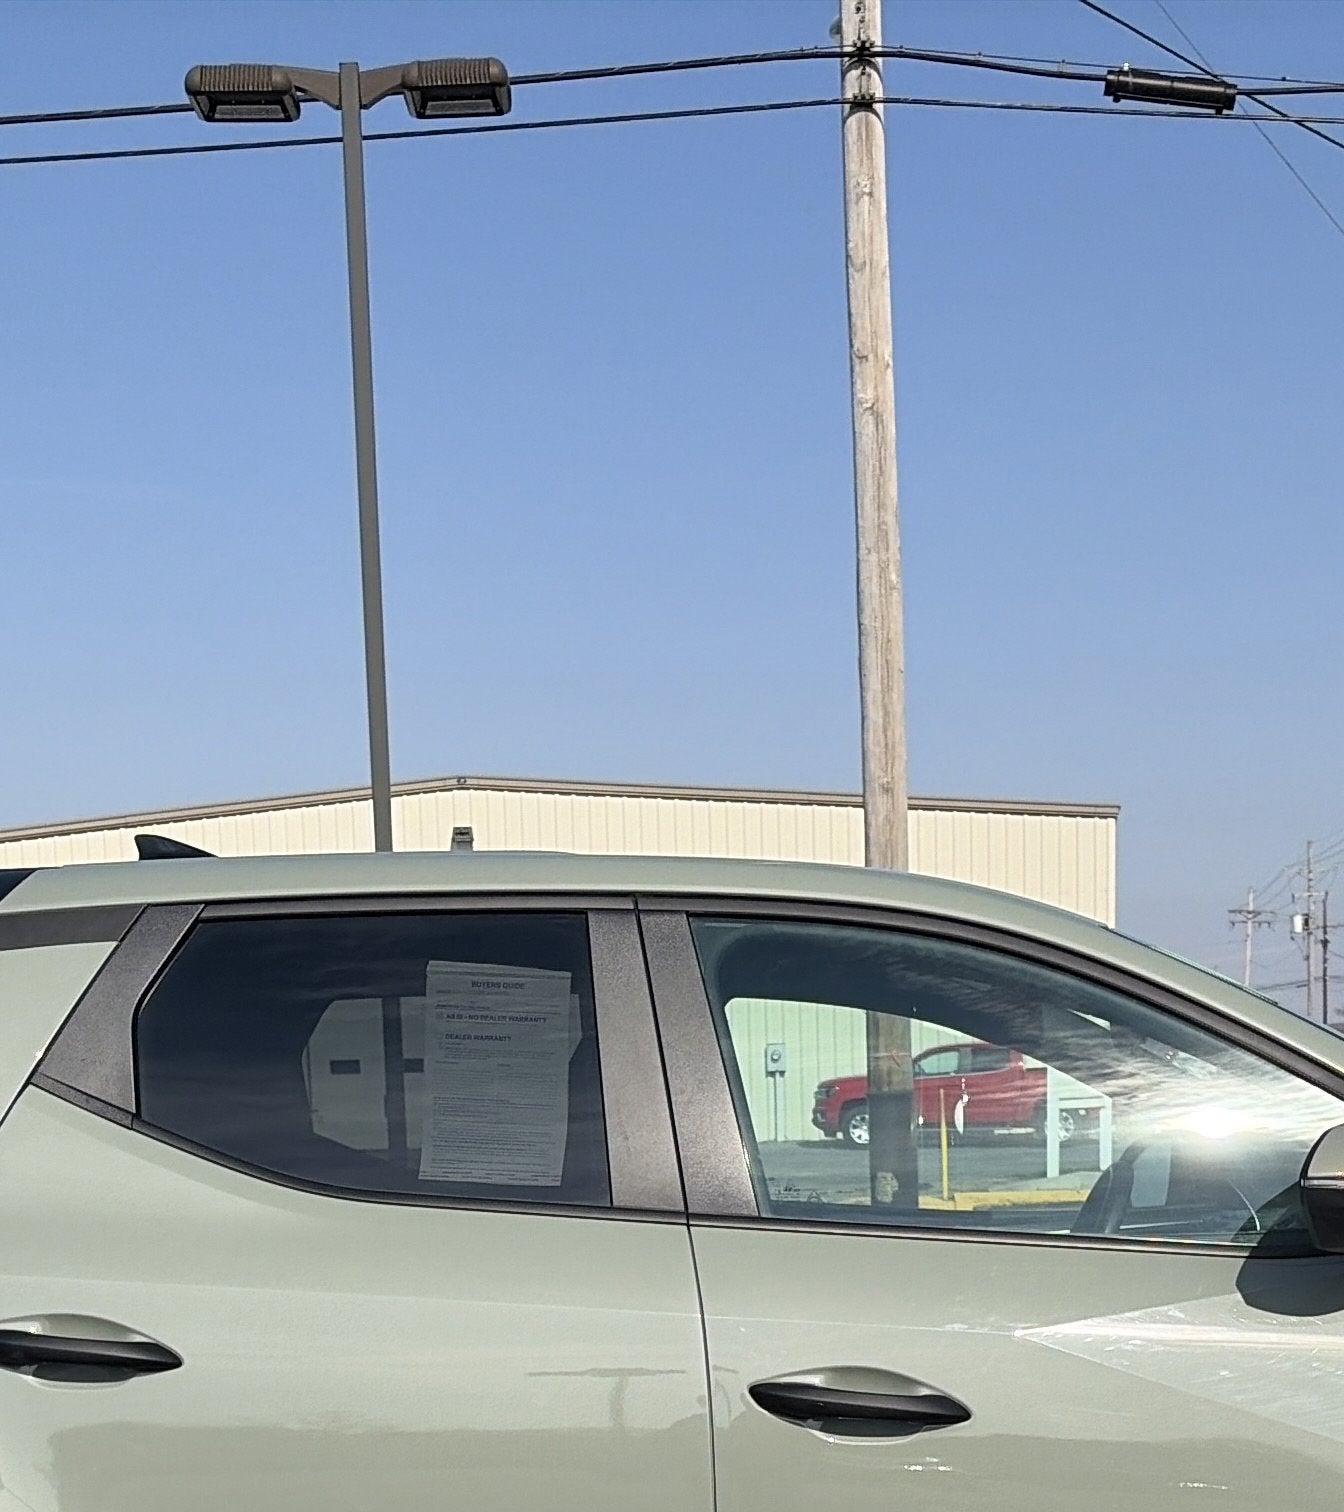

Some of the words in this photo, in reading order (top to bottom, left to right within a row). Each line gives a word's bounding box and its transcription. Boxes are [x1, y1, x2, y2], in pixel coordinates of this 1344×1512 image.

[471, 980, 501, 989] BUYERS
[502, 982, 525, 990] GUIDE
[508, 1015, 547, 1023] WARRANTY
[445, 1033, 472, 1041] DEALER
[473, 1034, 512, 1042] WARRANTY
